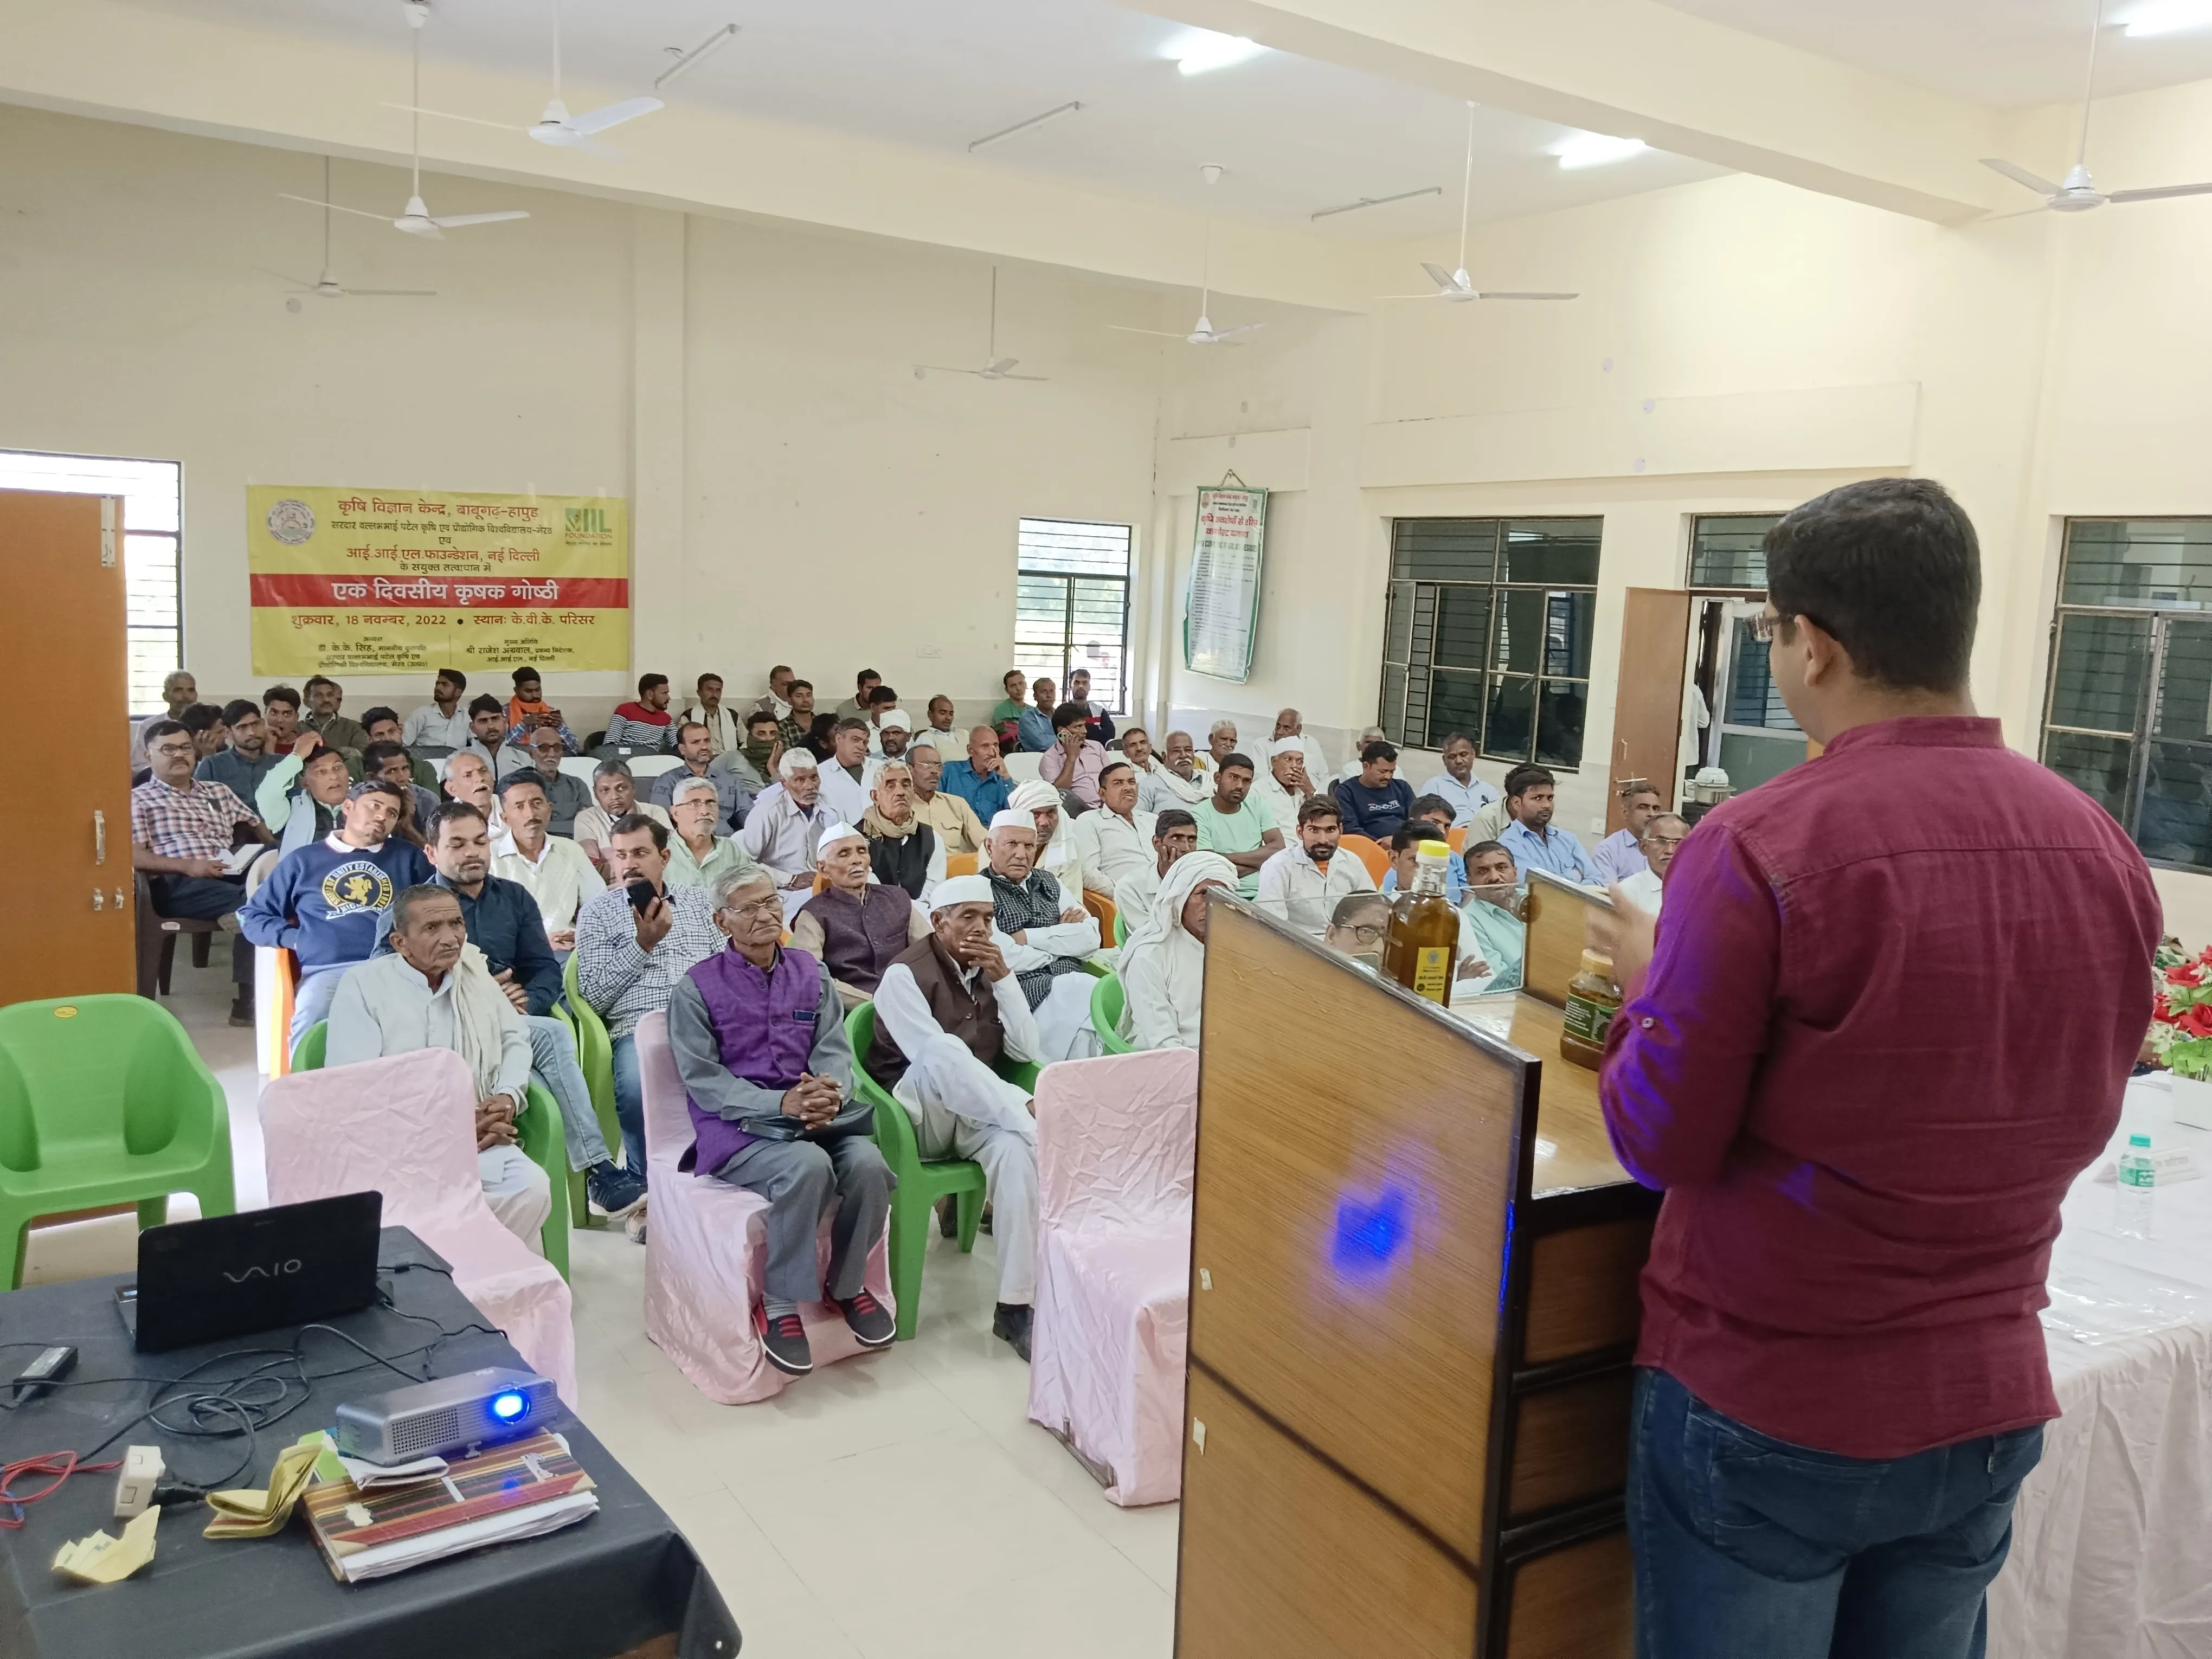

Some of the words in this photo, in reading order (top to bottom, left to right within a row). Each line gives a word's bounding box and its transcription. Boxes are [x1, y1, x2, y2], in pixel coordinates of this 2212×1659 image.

[338, 497, 367, 516] कृषि
[372, 497, 413, 513] विज्ञान
[331, 521, 356, 529] सरदार
[359, 520, 398, 532] वल्लभभाई
[400, 520, 418, 531] पटेल
[421, 521, 436, 533] कृषि
[487, 547, 505, 563] नई
[509, 548, 539, 562] दिल्ली
[400, 561, 408, 570] के
[331, 583, 368, 600] एक
[374, 577, 448, 599] दिवसीय
[454, 584, 506, 605] कृषक
[511, 578, 559, 600] गोष्ठी
[345, 615, 358, 625] 18
[415, 615, 446, 625] 2022
[560, 612, 595, 625] परिसर
[466, 645, 475, 654] श्री
[478, 645, 499, 654] राजेश
[332, 864, 352, 878] UNITY
[355, 863, 390, 891] ESTABLISHED
[223, 1259, 302, 1283] VAIO
